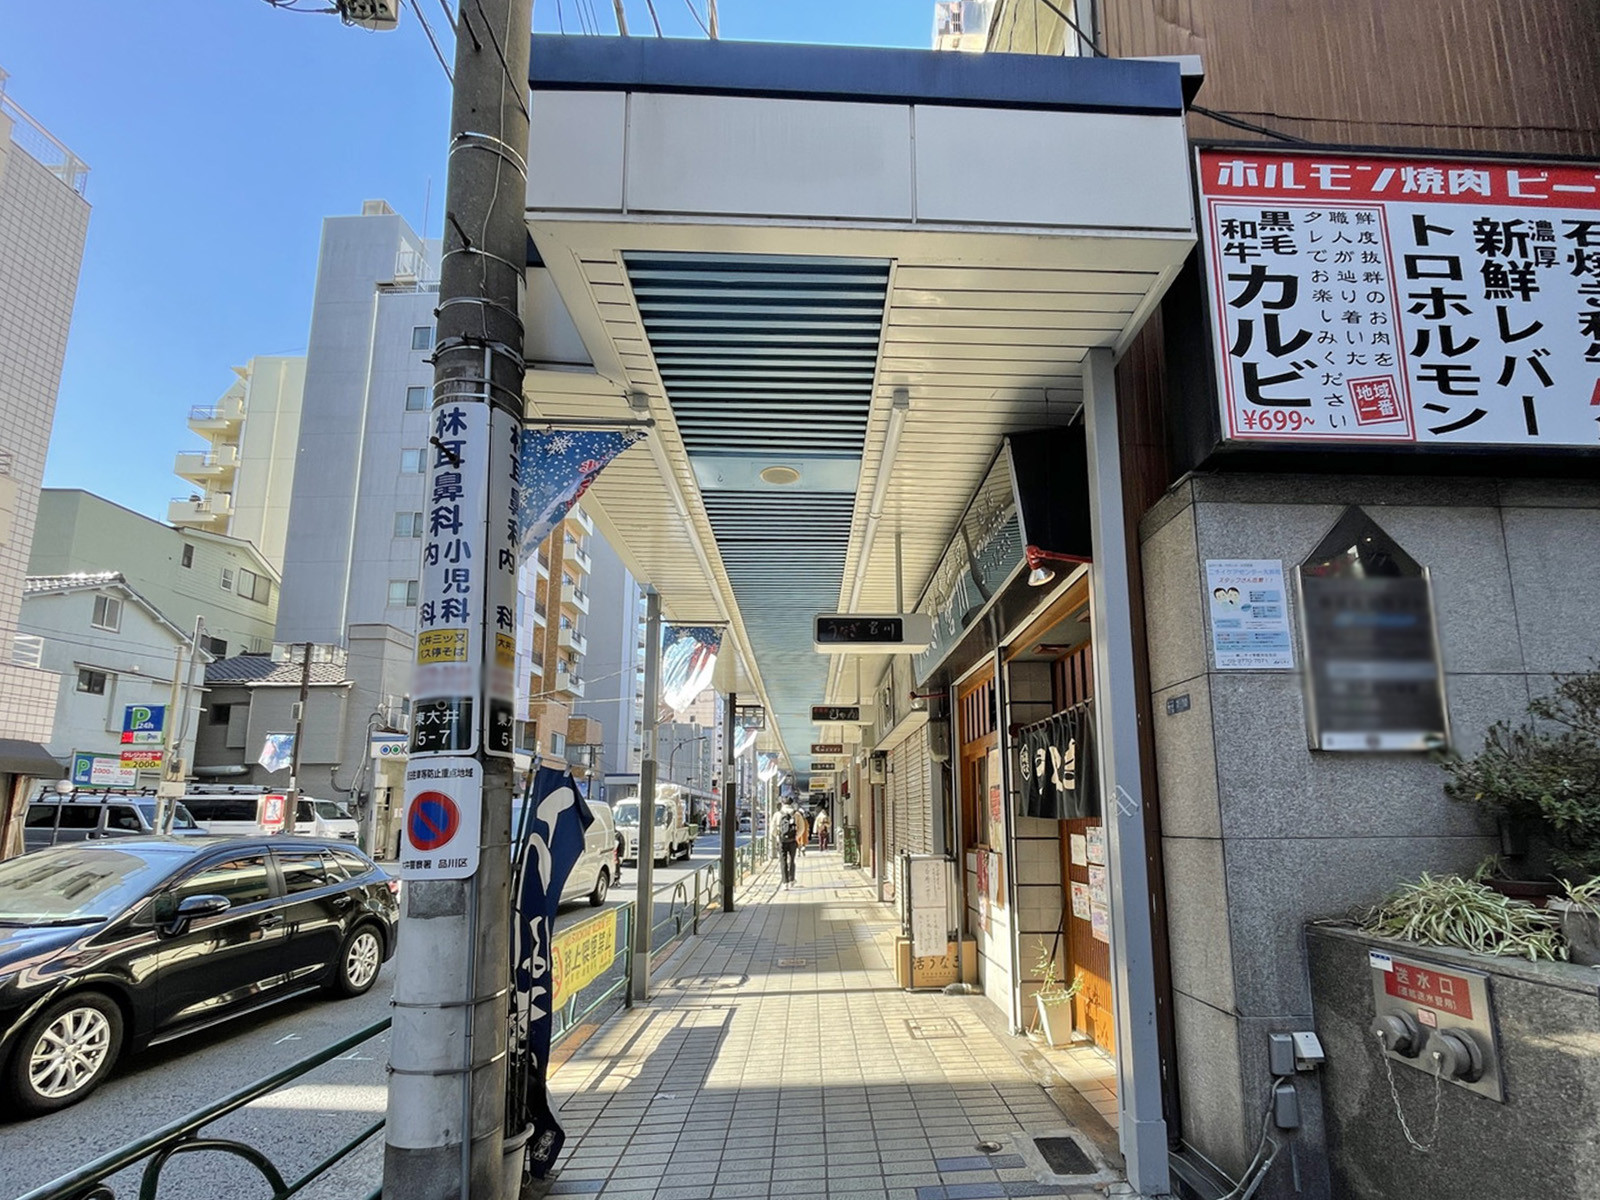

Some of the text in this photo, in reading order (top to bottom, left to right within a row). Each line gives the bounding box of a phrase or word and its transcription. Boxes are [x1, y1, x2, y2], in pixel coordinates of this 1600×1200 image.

[1217, 160, 1600, 199] ホルモン焼肉 ビー
[1220, 218, 1262, 264] 和牛
[1258, 210, 1298, 256] 黒毛
[1526, 219, 1561, 269] 濃厚
[1302, 209, 1348, 430] タレでお楽しみください
[1328, 210, 1369, 367] 職人が辿り着いた
[1354, 210, 1395, 367] 鮮度抜群のお肉を
[1227, 264, 1319, 408] カルビ
[1403, 213, 1489, 436] トロホルモン
[1473, 216, 1555, 437] 新鮮レバー
[1355, 380, 1392, 402] 地域
[1360, 399, 1396, 417] 一番
[429, 406, 468, 538] 林耳鼻科
[419, 541, 440, 628] 内科
[440, 538, 472, 624] 小児科
[496, 548, 516, 634] 内科
[414, 710, 460, 727] 東大井
[416, 729, 451, 747] 5-7
[437, 857, 469, 869] 品川区
[1394, 965, 1455, 996] 送水口
